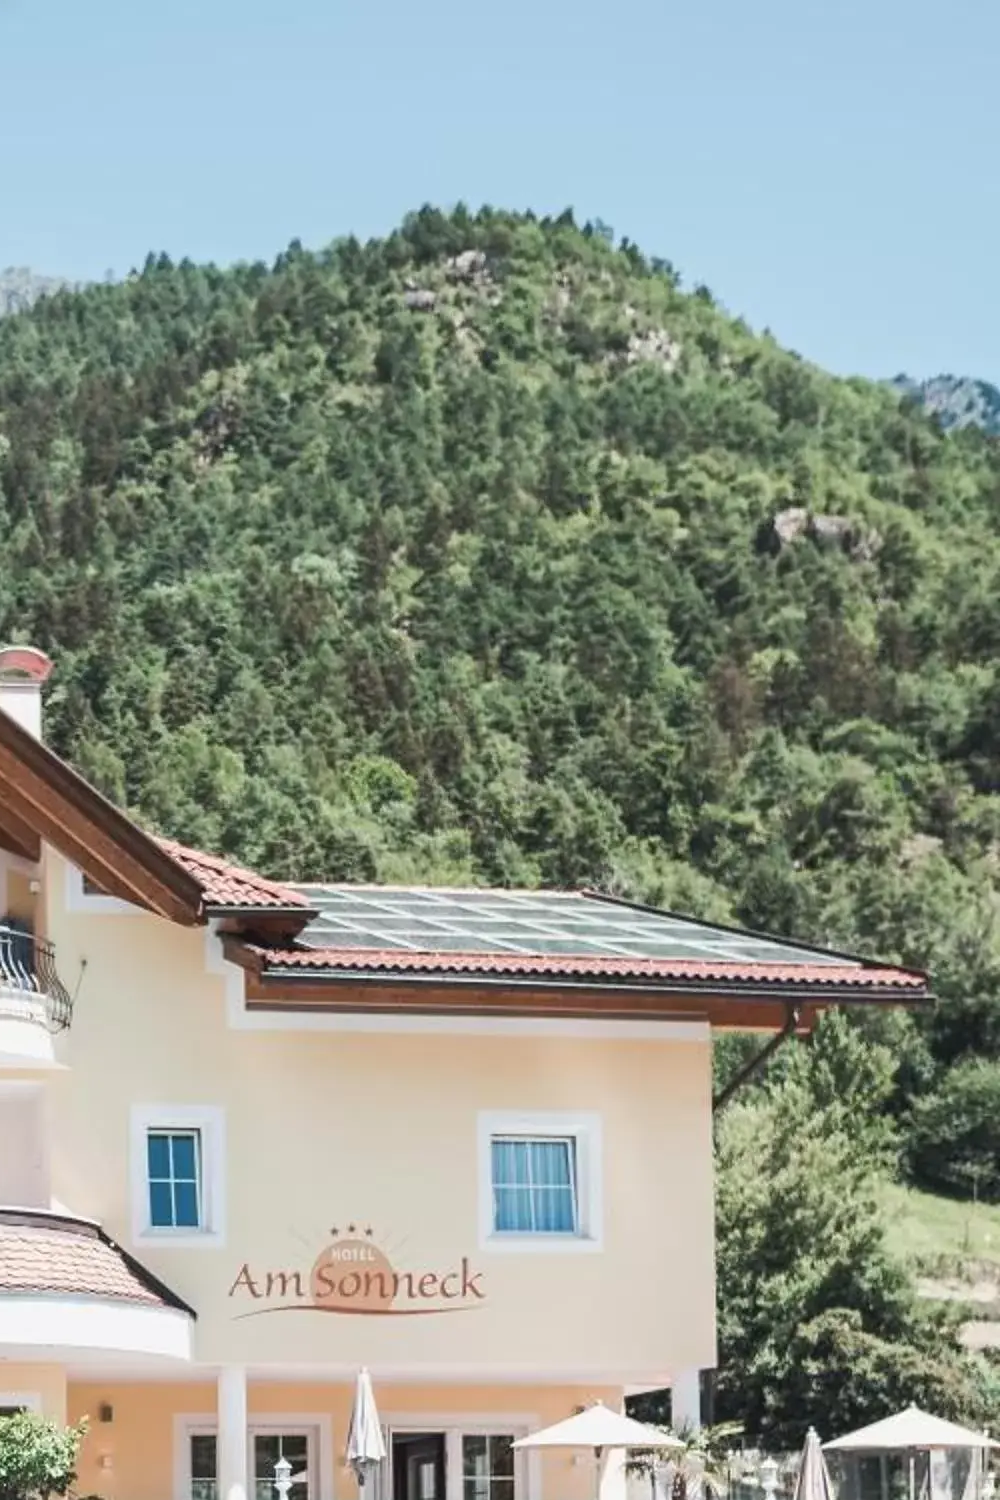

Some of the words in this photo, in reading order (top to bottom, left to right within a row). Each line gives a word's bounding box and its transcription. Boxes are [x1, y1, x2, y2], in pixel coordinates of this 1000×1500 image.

[331, 1247, 375, 1262] HOTEL
[228, 1263, 304, 1298] Am
[315, 1257, 486, 1299] Sonneck
